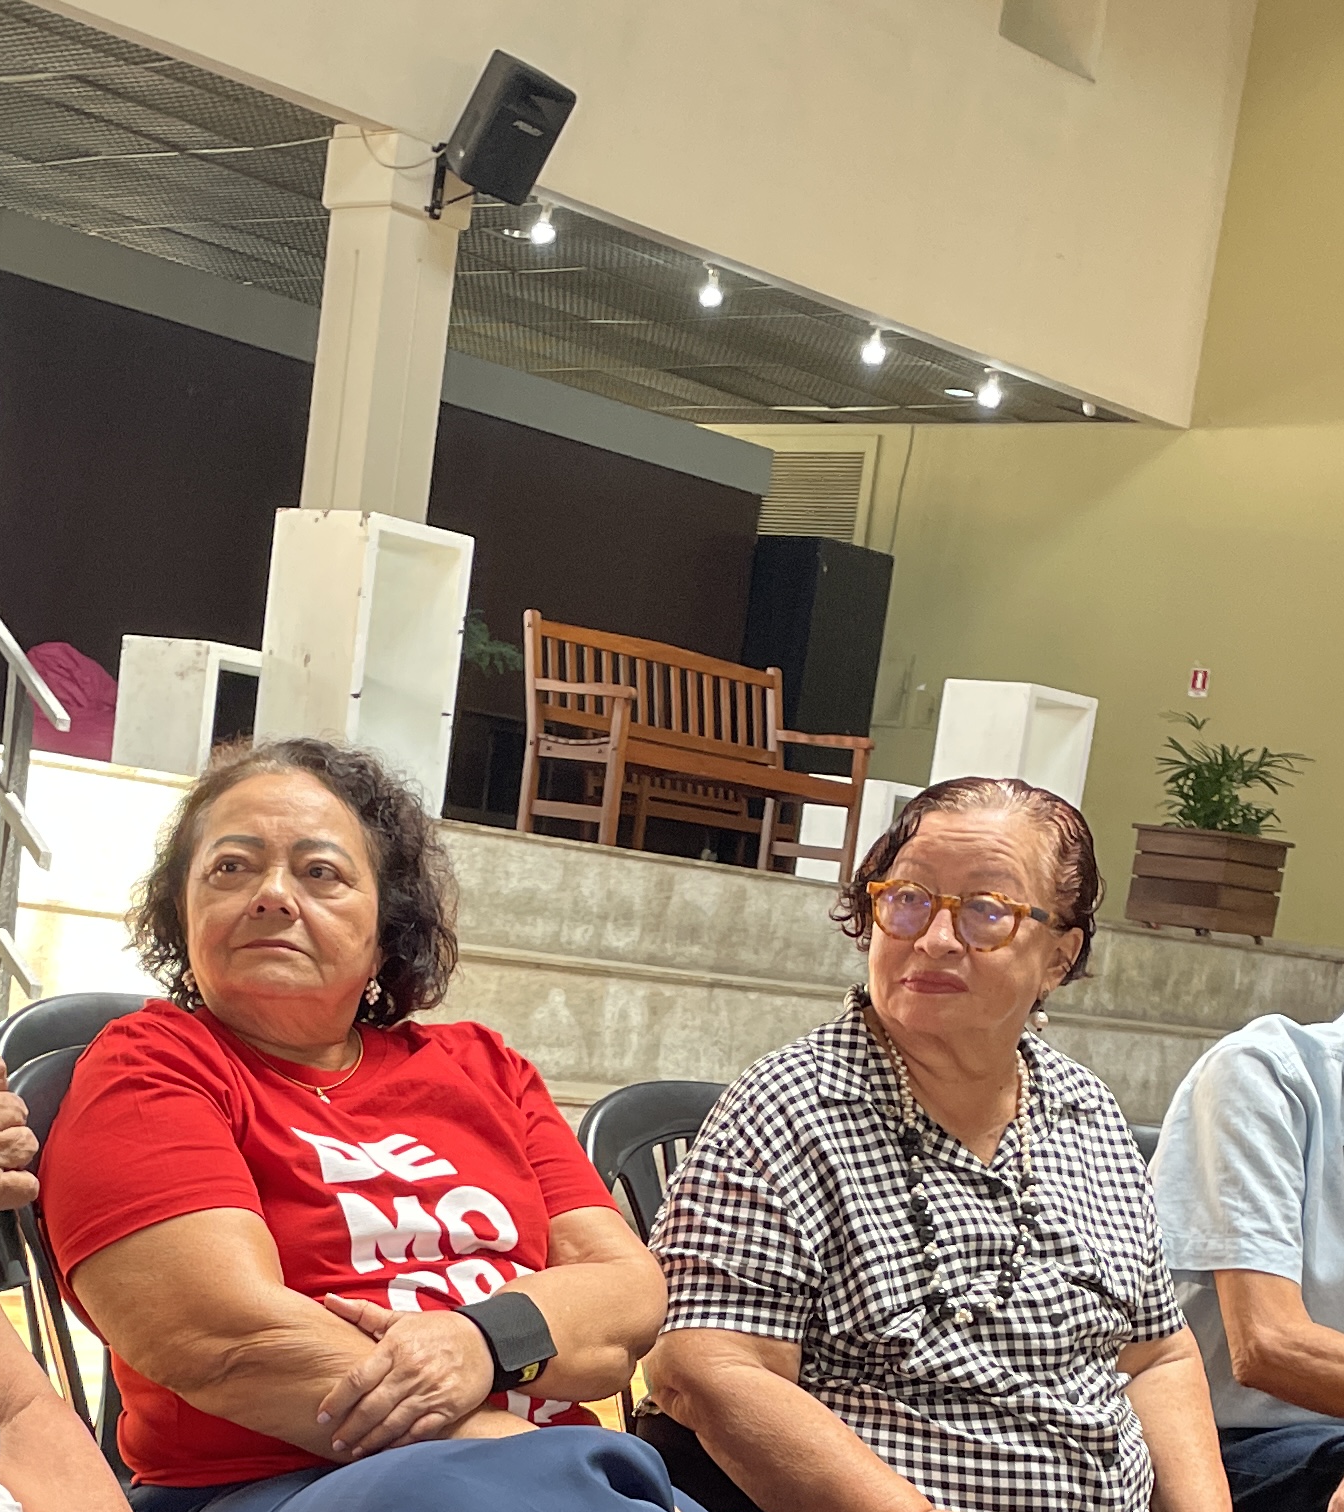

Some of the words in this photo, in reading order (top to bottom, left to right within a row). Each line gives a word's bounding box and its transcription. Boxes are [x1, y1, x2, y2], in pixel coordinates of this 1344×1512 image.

[290, 1126, 458, 1184] DE
[336, 1186, 519, 1274] MO
[387, 1258, 536, 1312] CR
